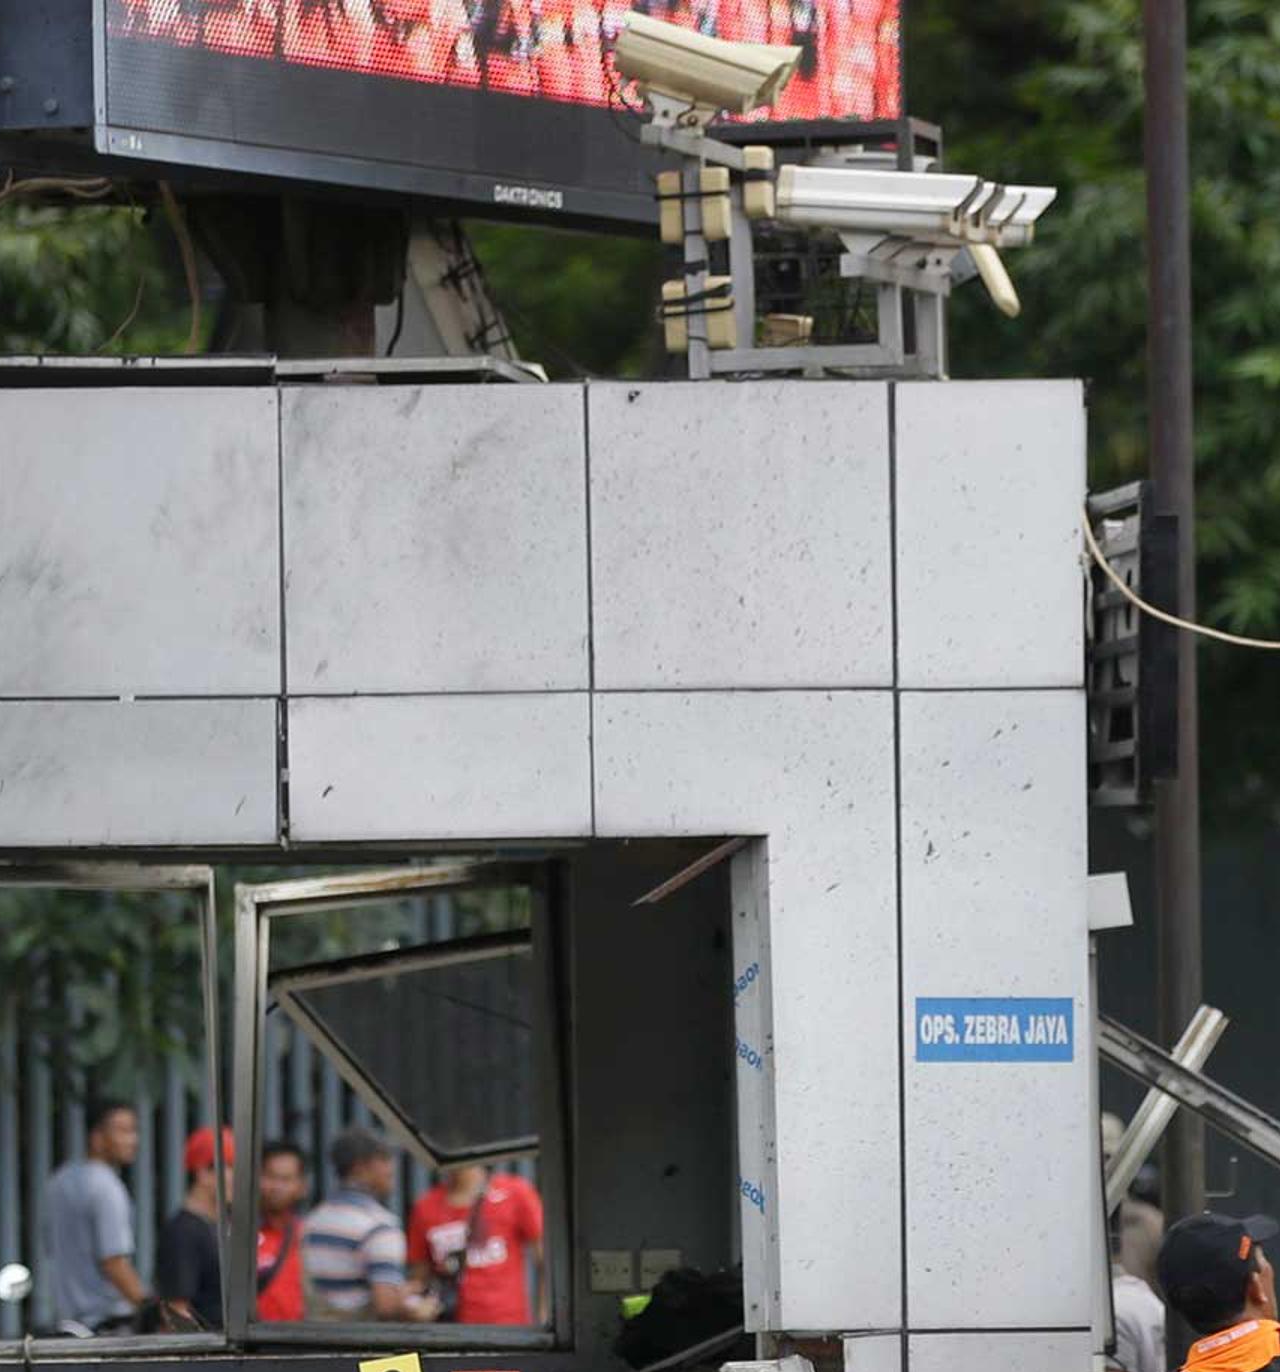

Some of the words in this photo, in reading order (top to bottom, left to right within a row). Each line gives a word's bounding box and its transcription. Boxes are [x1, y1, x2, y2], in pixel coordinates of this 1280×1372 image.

[921, 1014, 960, 1044] OPS.
[963, 1014, 1020, 1044] ZEBRA
[1024, 1014, 1068, 1044] JAYA
